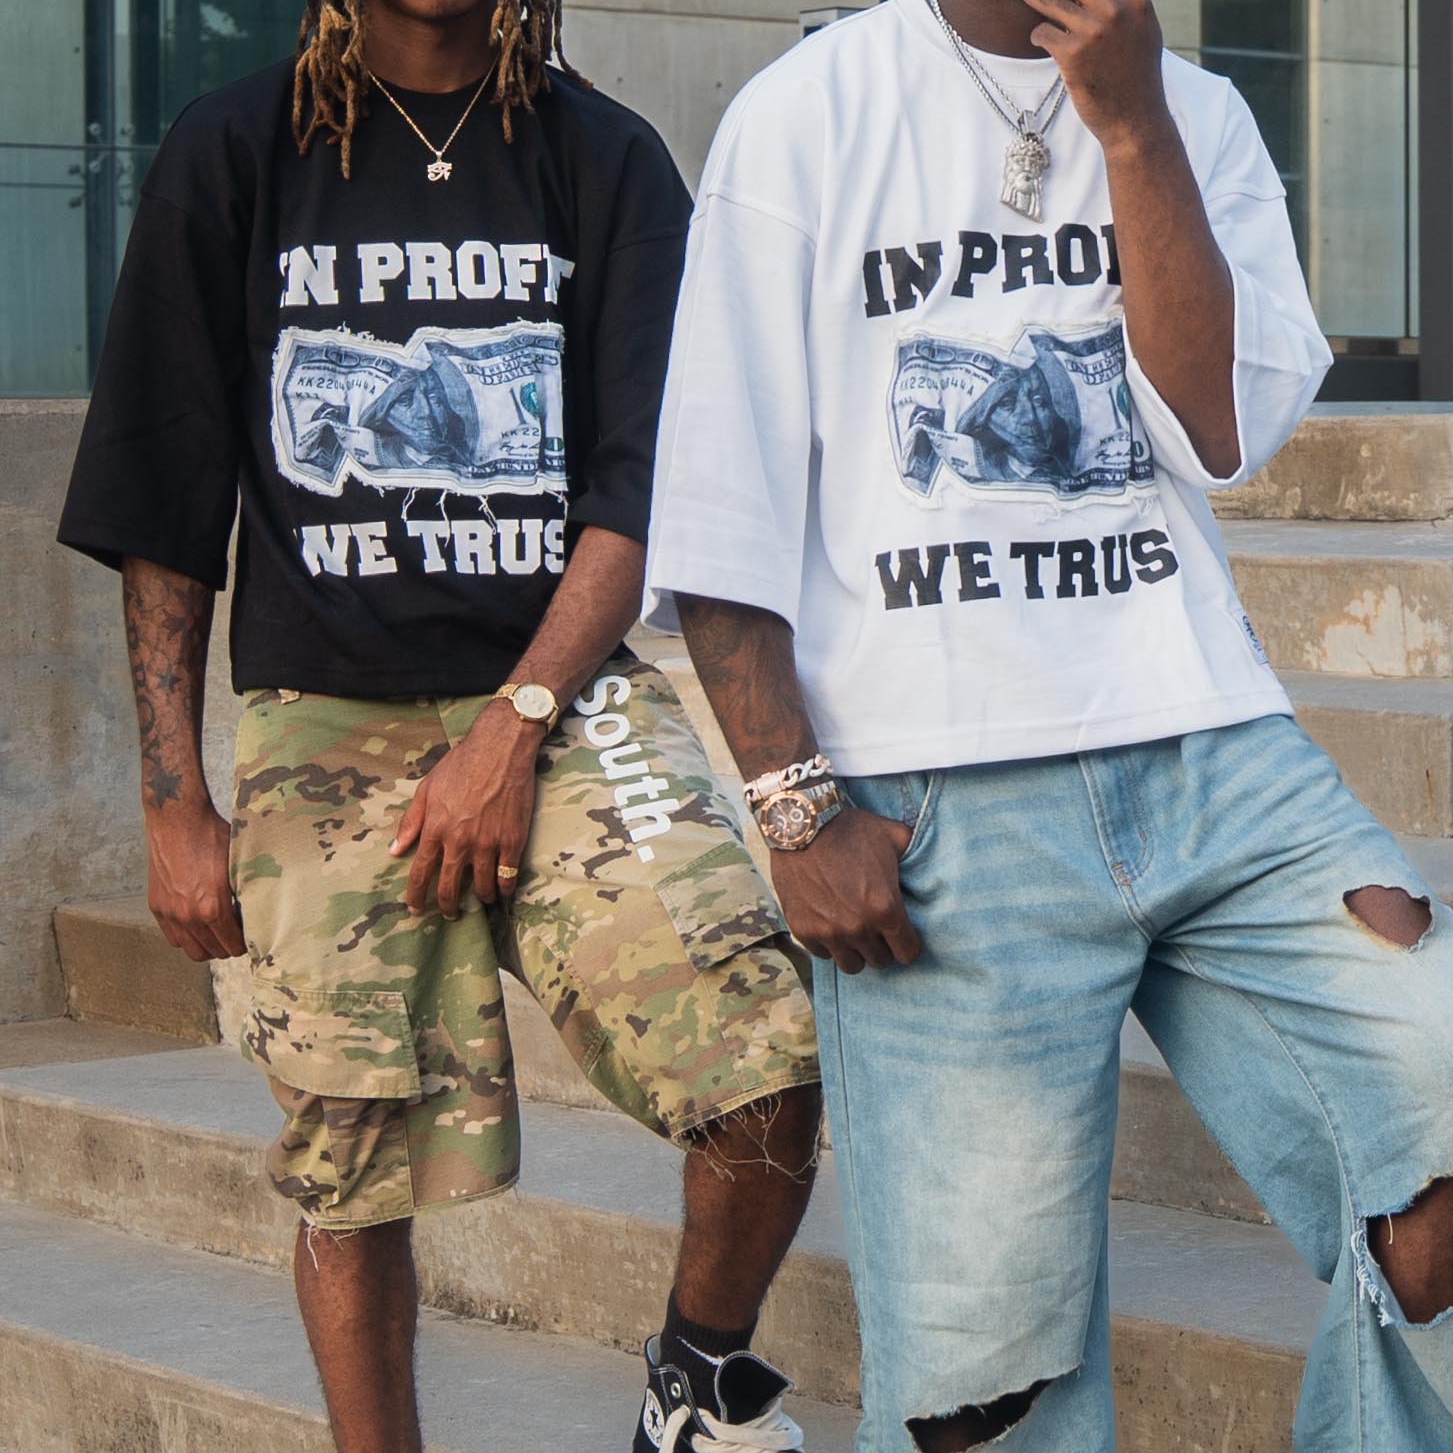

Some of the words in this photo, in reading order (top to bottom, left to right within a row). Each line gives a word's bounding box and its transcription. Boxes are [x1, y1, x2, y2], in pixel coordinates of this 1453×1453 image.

[862, 240, 944, 320] IN
[874, 540, 1002, 611] WE
[573, 675, 681, 864] South.
